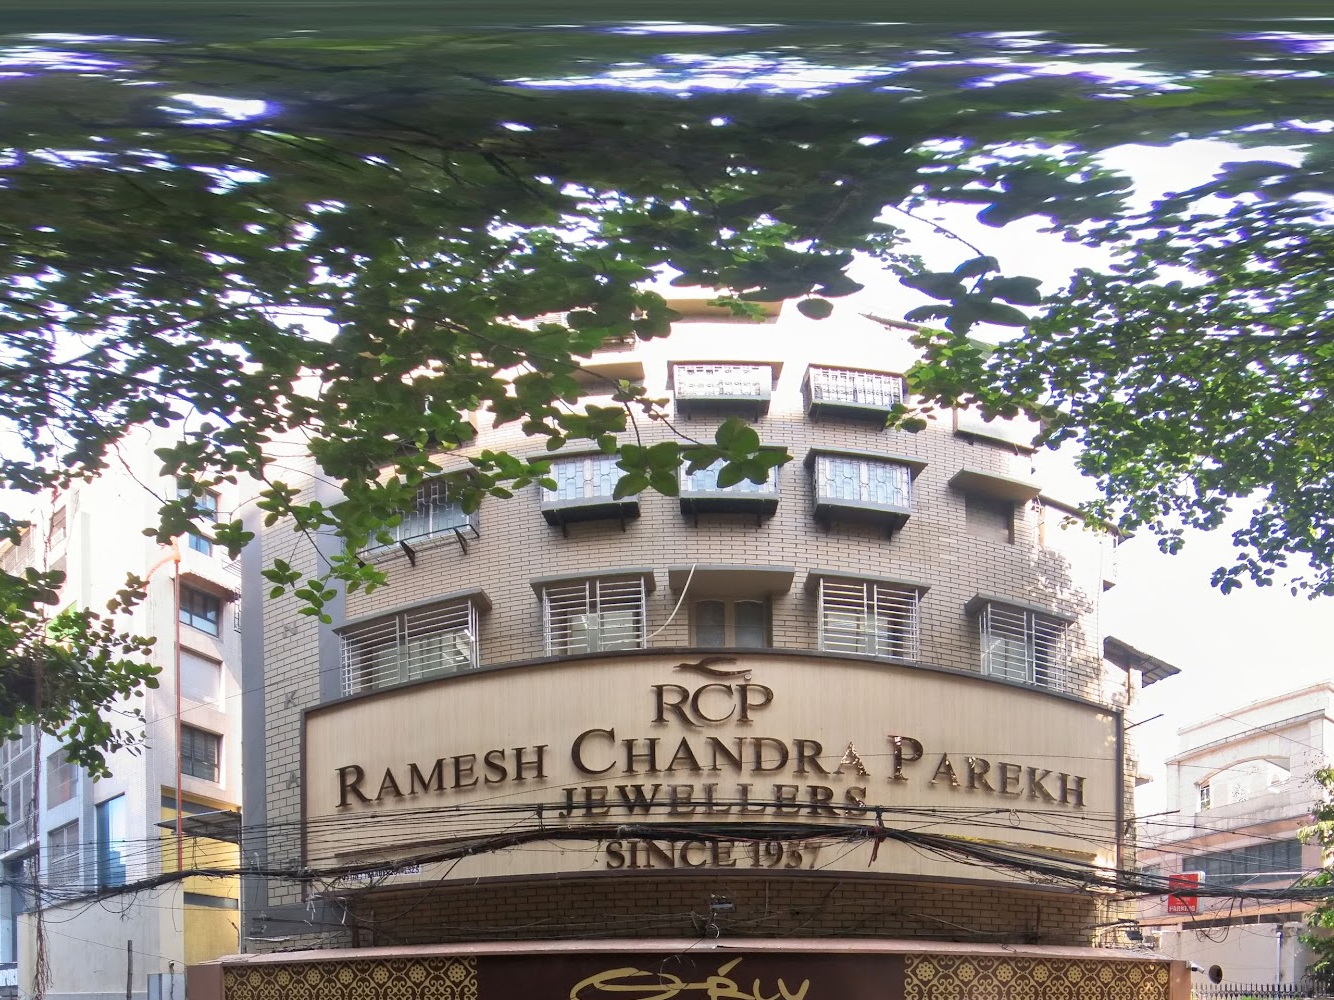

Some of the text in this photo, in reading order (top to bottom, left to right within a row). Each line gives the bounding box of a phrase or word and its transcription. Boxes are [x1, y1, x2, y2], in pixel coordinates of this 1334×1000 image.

[650, 683, 774, 727] RCP
[334, 727, 1088, 808] RAMESH CHANDRA PAREKH
[558, 782, 868, 818] JEWELLERS
[605, 838, 737, 870] SINCE
